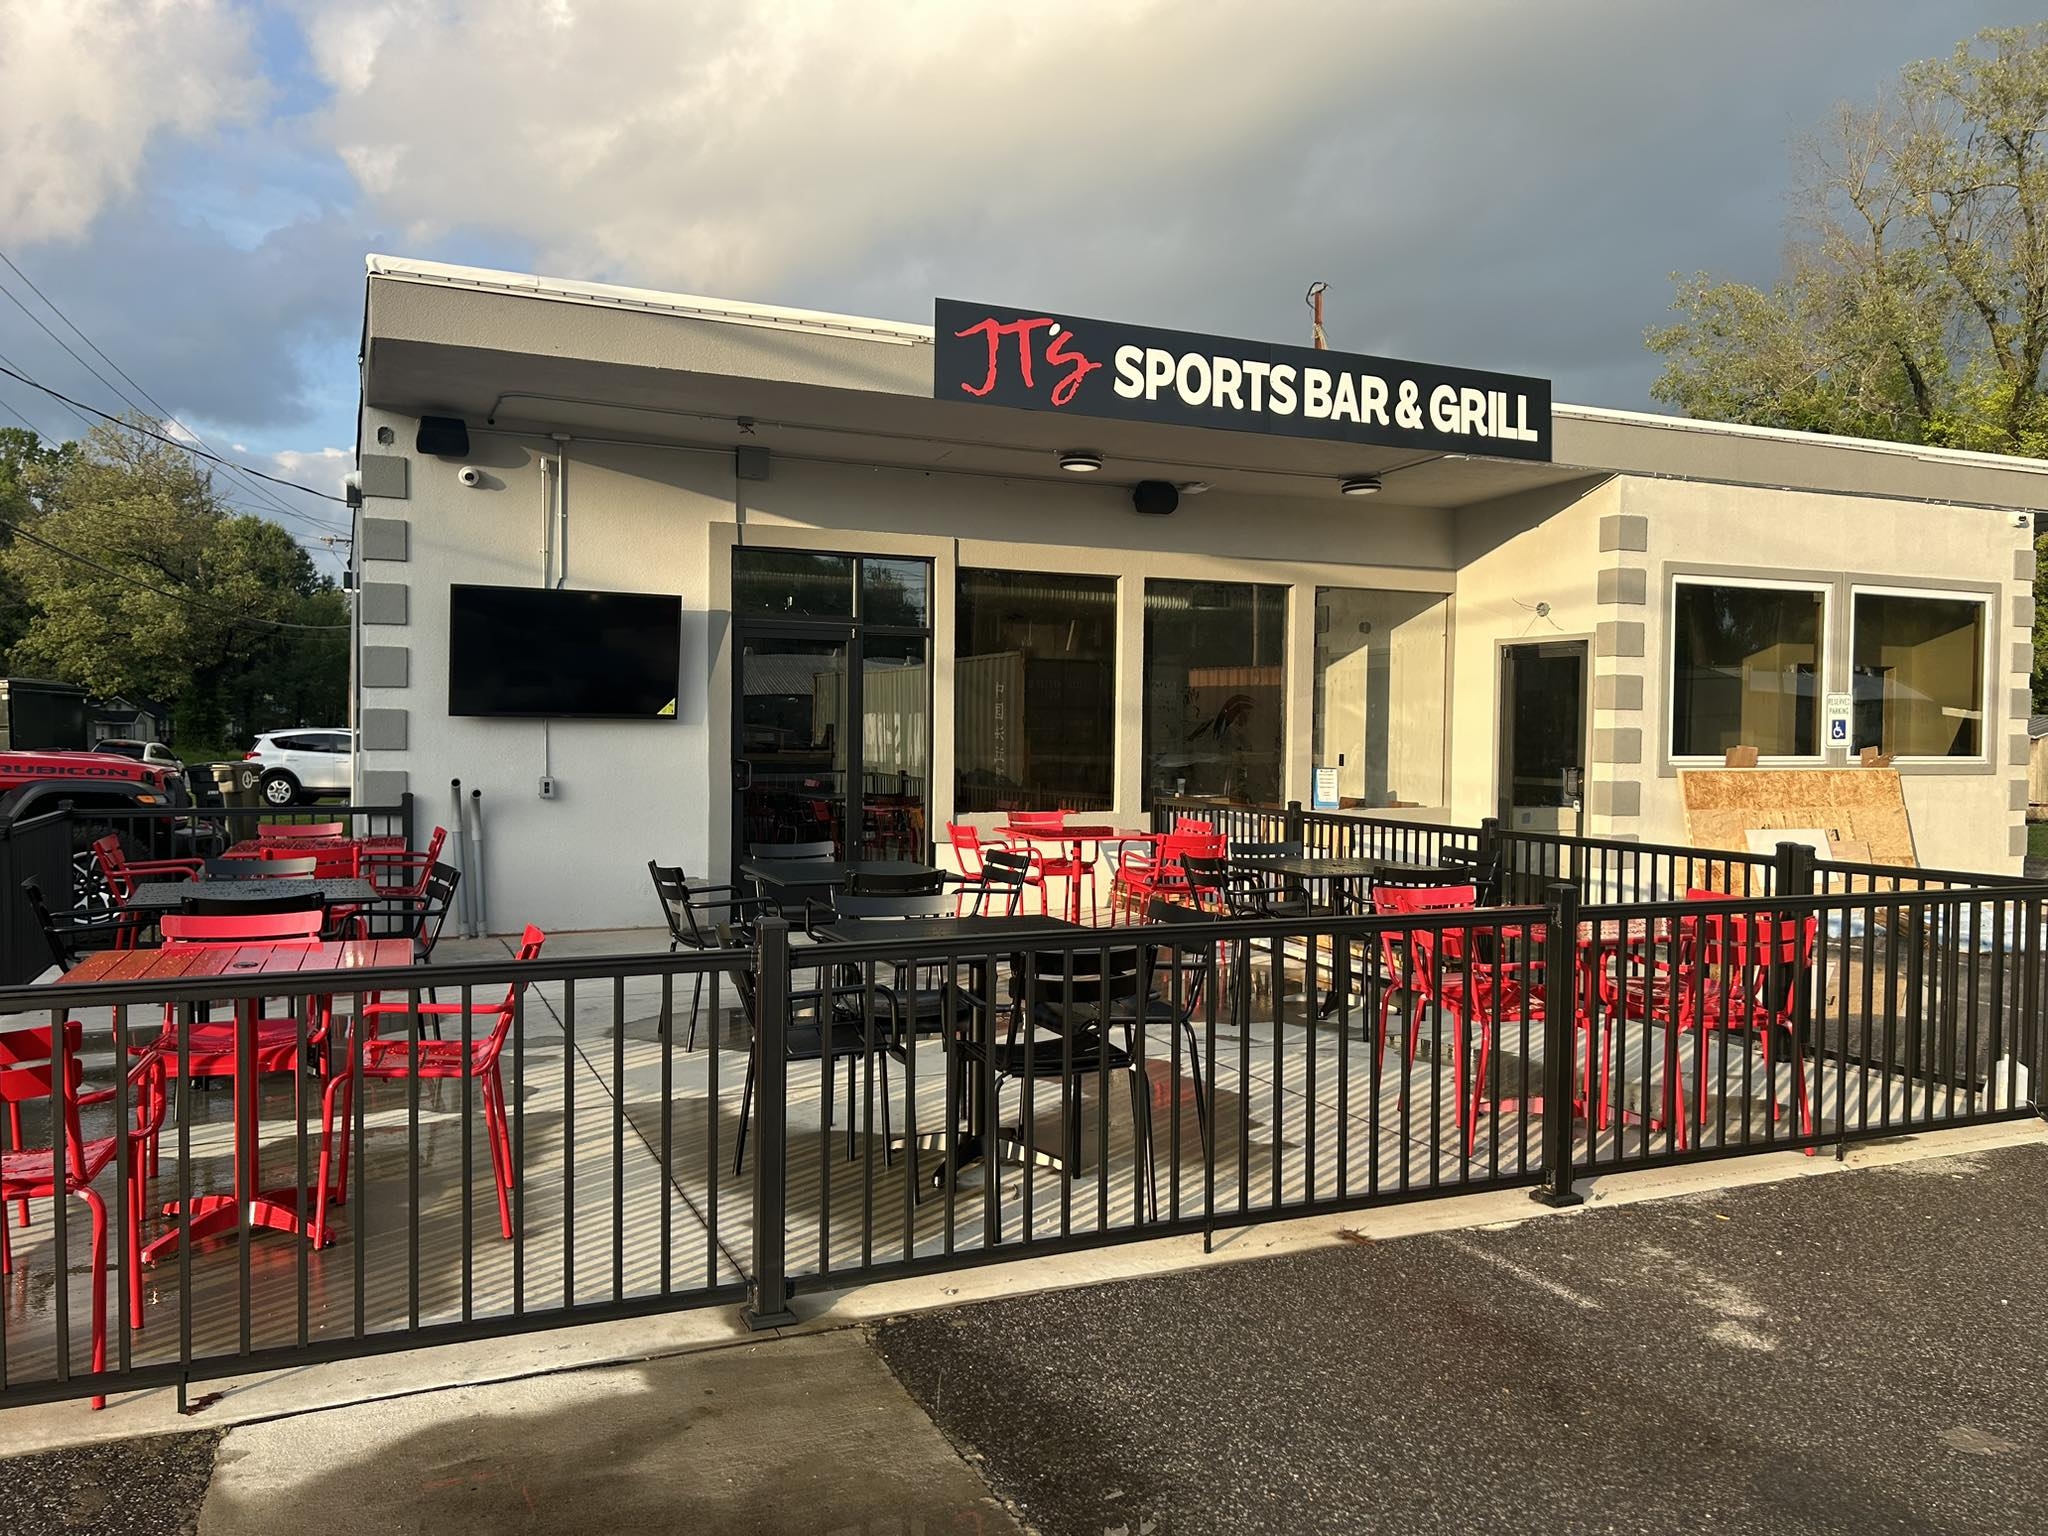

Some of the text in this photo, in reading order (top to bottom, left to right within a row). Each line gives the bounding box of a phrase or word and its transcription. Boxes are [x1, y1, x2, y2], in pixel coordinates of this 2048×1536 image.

[954, 317, 1538, 442] JT's SPORTS BAR & GRILL
[1828, 697, 1850, 706] RESERVED
[1829, 707, 1849, 715] PARKING
[0, 764, 129, 777] RUBICON
